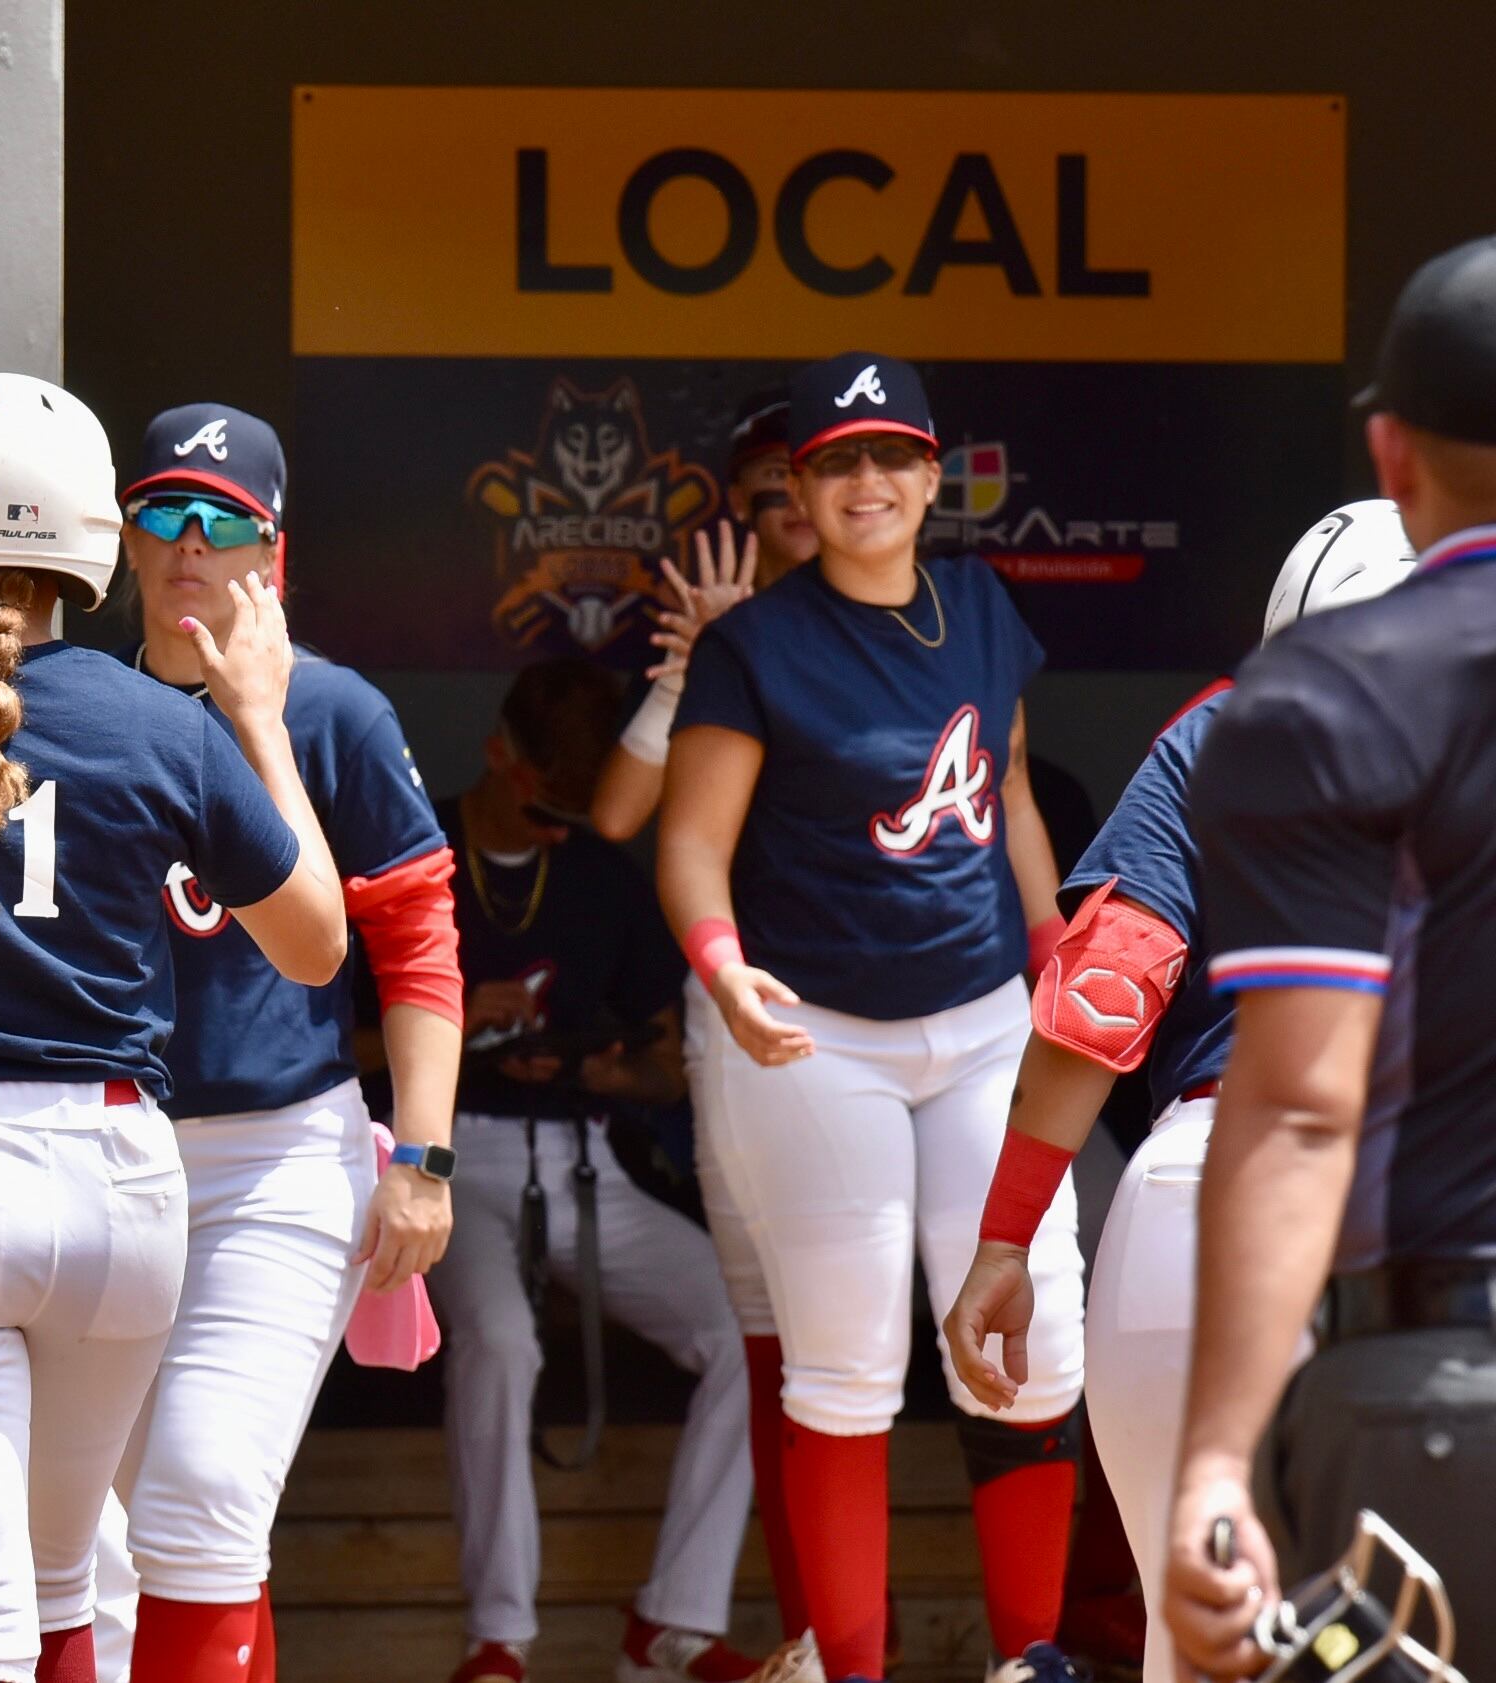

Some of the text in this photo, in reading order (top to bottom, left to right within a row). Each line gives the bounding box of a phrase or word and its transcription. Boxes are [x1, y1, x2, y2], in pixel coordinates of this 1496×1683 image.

[517, 145, 1152, 298] LOCAL
[833, 364, 887, 409] A
[174, 418, 228, 462] A
[512, 515, 664, 551] ARECIBO
[869, 704, 997, 858] A
